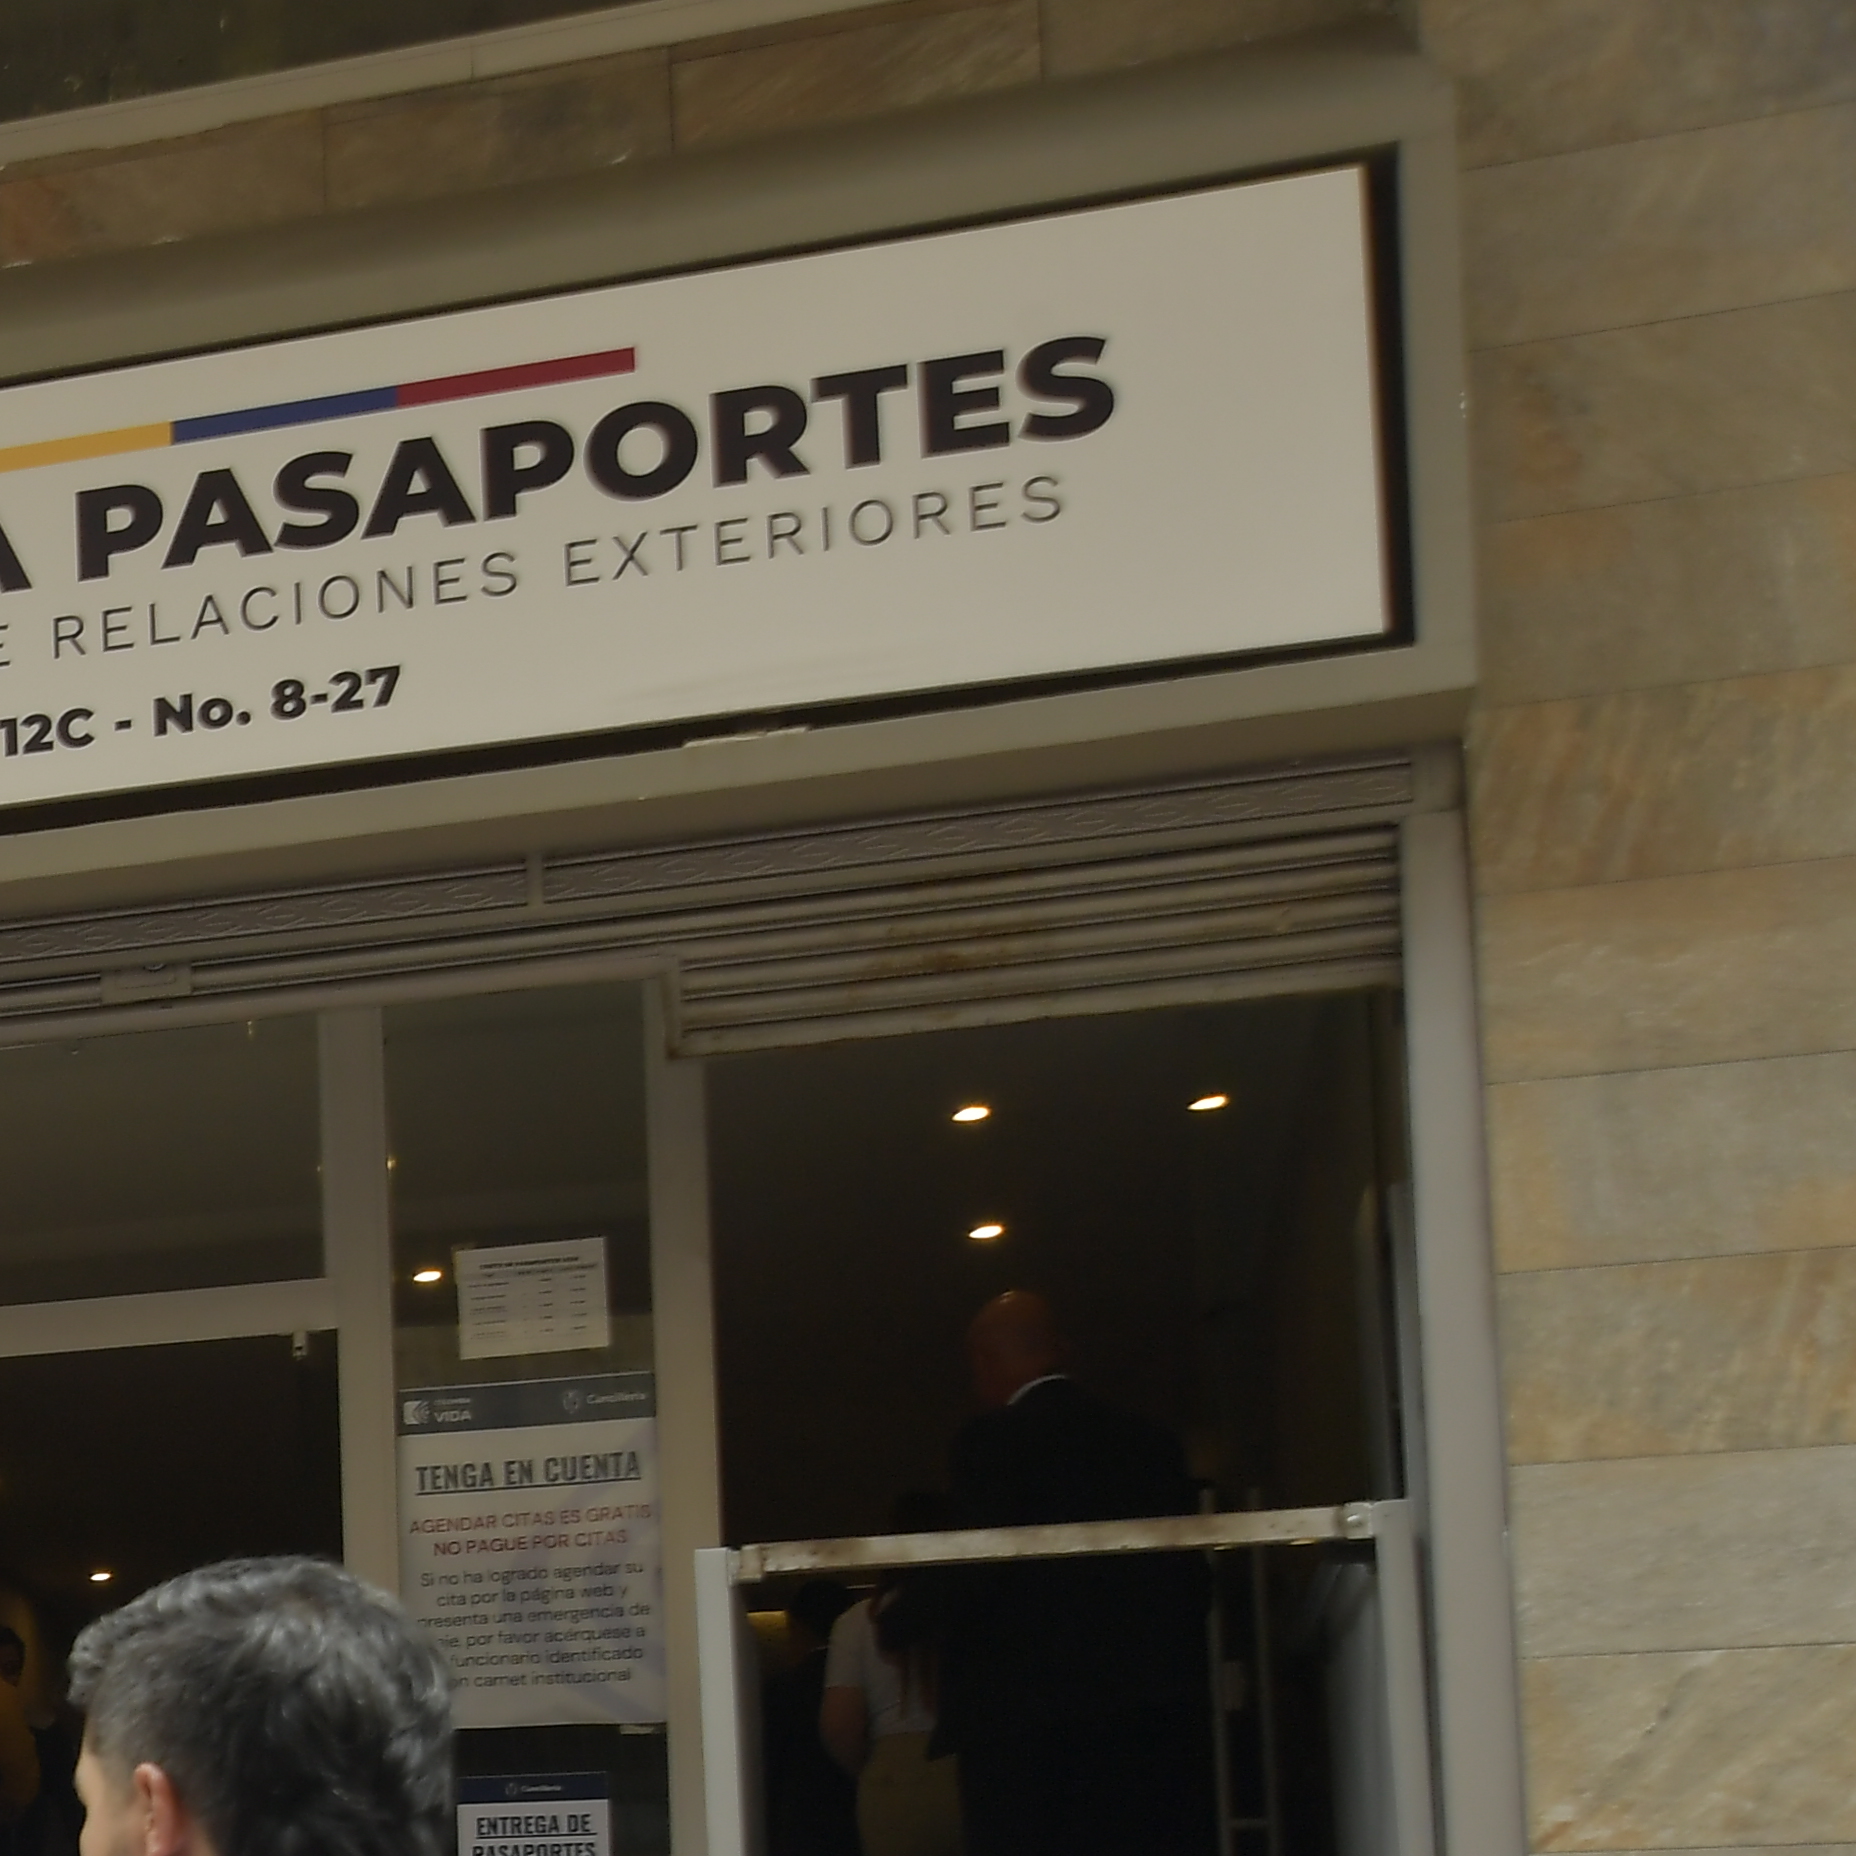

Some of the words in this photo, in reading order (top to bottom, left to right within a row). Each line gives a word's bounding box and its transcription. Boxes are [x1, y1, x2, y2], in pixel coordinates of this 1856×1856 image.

[76, 335, 1116, 582] PASAPORTES
[54, 550, 520, 659] RELACIONES
[565, 475, 1065, 587] EXTERIORES
[154, 693, 252, 737] No.
[270, 665, 401, 720] 8-27
[434, 1410, 472, 1423] VIDA
[416, 1461, 495, 1491] TENGA
[503, 1459, 534, 1485] EN
[544, 1451, 641, 1482] CUENTA
[409, 1513, 497, 1534] AGENDAR
[502, 1510, 555, 1528] CITAS
[560, 1508, 581, 1524] ES
[585, 1503, 652, 1523] GRATIS
[433, 1541, 461, 1556] NO
[466, 1535, 528, 1554] PAGUE
[533, 1532, 569, 1550] POR
[575, 1529, 628, 1547] CITAS
[420, 1572, 434, 1587] Si
[438, 1574, 459, 1586] no
[463, 1569, 482, 1584] ha
[488, 1563, 548, 1585] logrado
[553, 1562, 620, 1582] agendar
[625, 1562, 644, 1575] su
[436, 1592, 467, 1608] cita
[470, 1593, 498, 1610] por
[502, 1588, 516, 1603] la
[580, 1583, 614, 1598] web
[492, 1611, 522, 1624] una
[527, 1605, 625, 1625] emergencia
[628, 1602, 651, 1617] de
[466, 1634, 493, 1650] por
[498, 1630, 540, 1645] favor
[635, 1627, 645, 1639] a
[450, 1652, 540, 1669] funcionario
[545, 1646, 644, 1665] identificado
[474, 1672, 527, 1688] carnet
[531, 1668, 632, 1686] institucional
[476, 1814, 560, 1836] ENTREGA
[567, 1813, 592, 1833] DE
